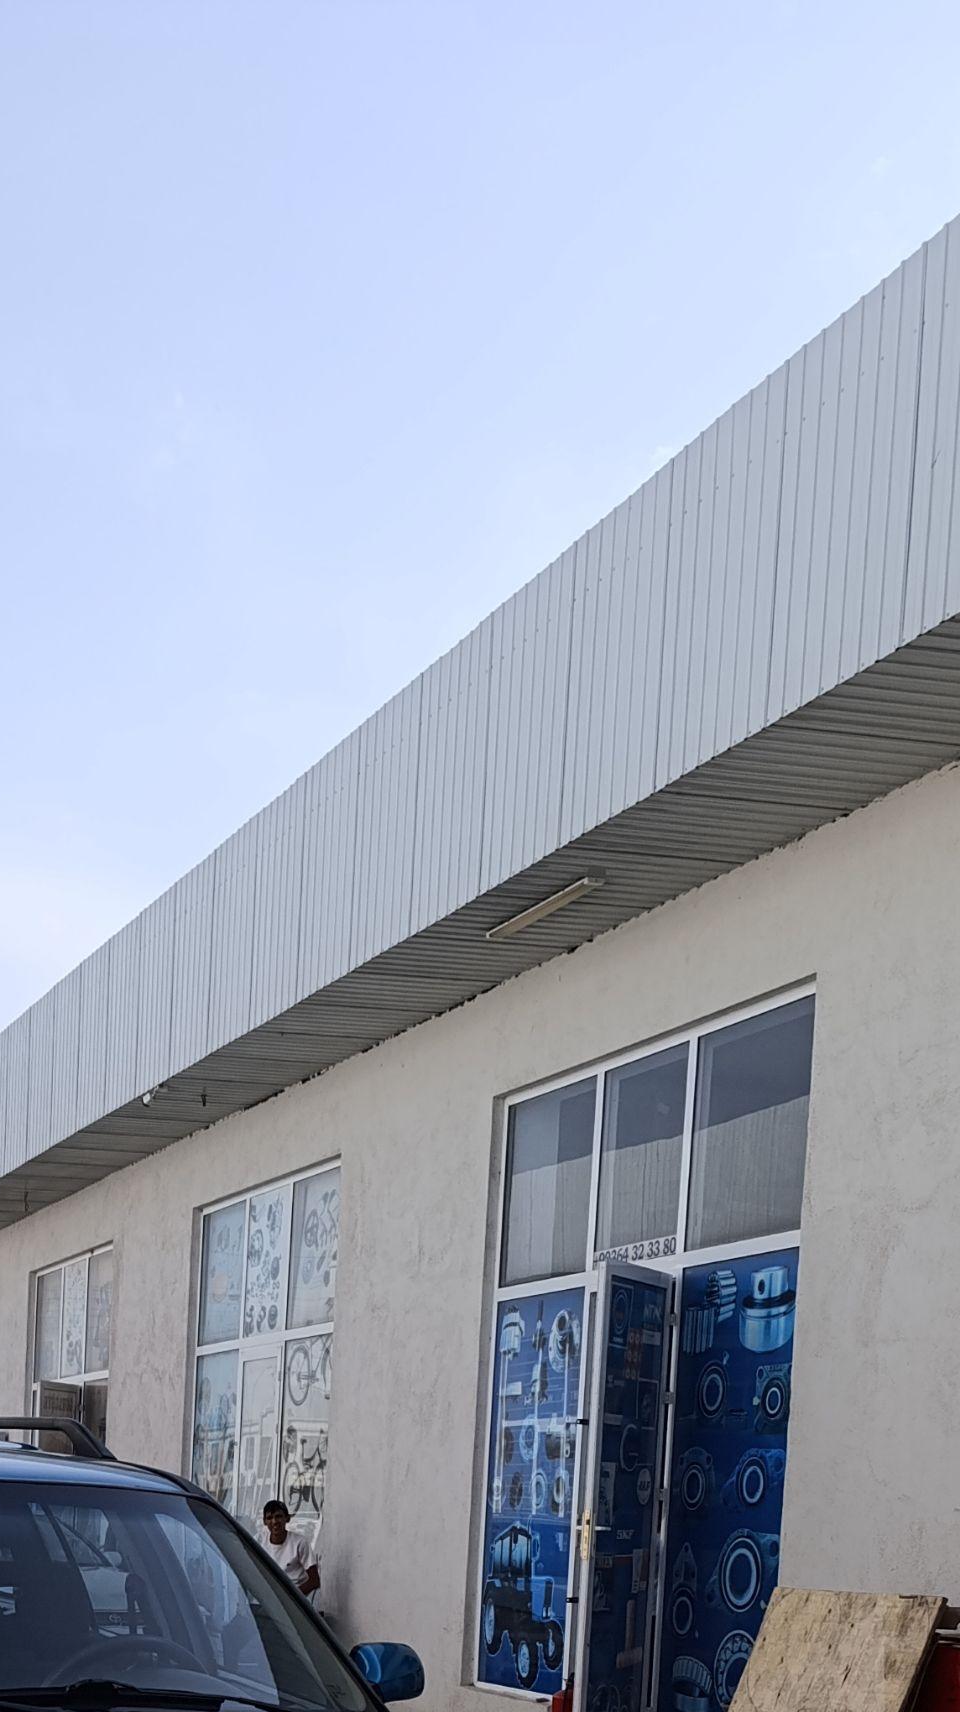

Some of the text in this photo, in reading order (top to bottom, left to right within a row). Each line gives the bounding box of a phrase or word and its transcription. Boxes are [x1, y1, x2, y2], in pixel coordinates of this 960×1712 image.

[632, 1243, 645, 1261] 32
[647, 1240, 661, 1258] 33
[663, 1237, 677, 1255] 80
